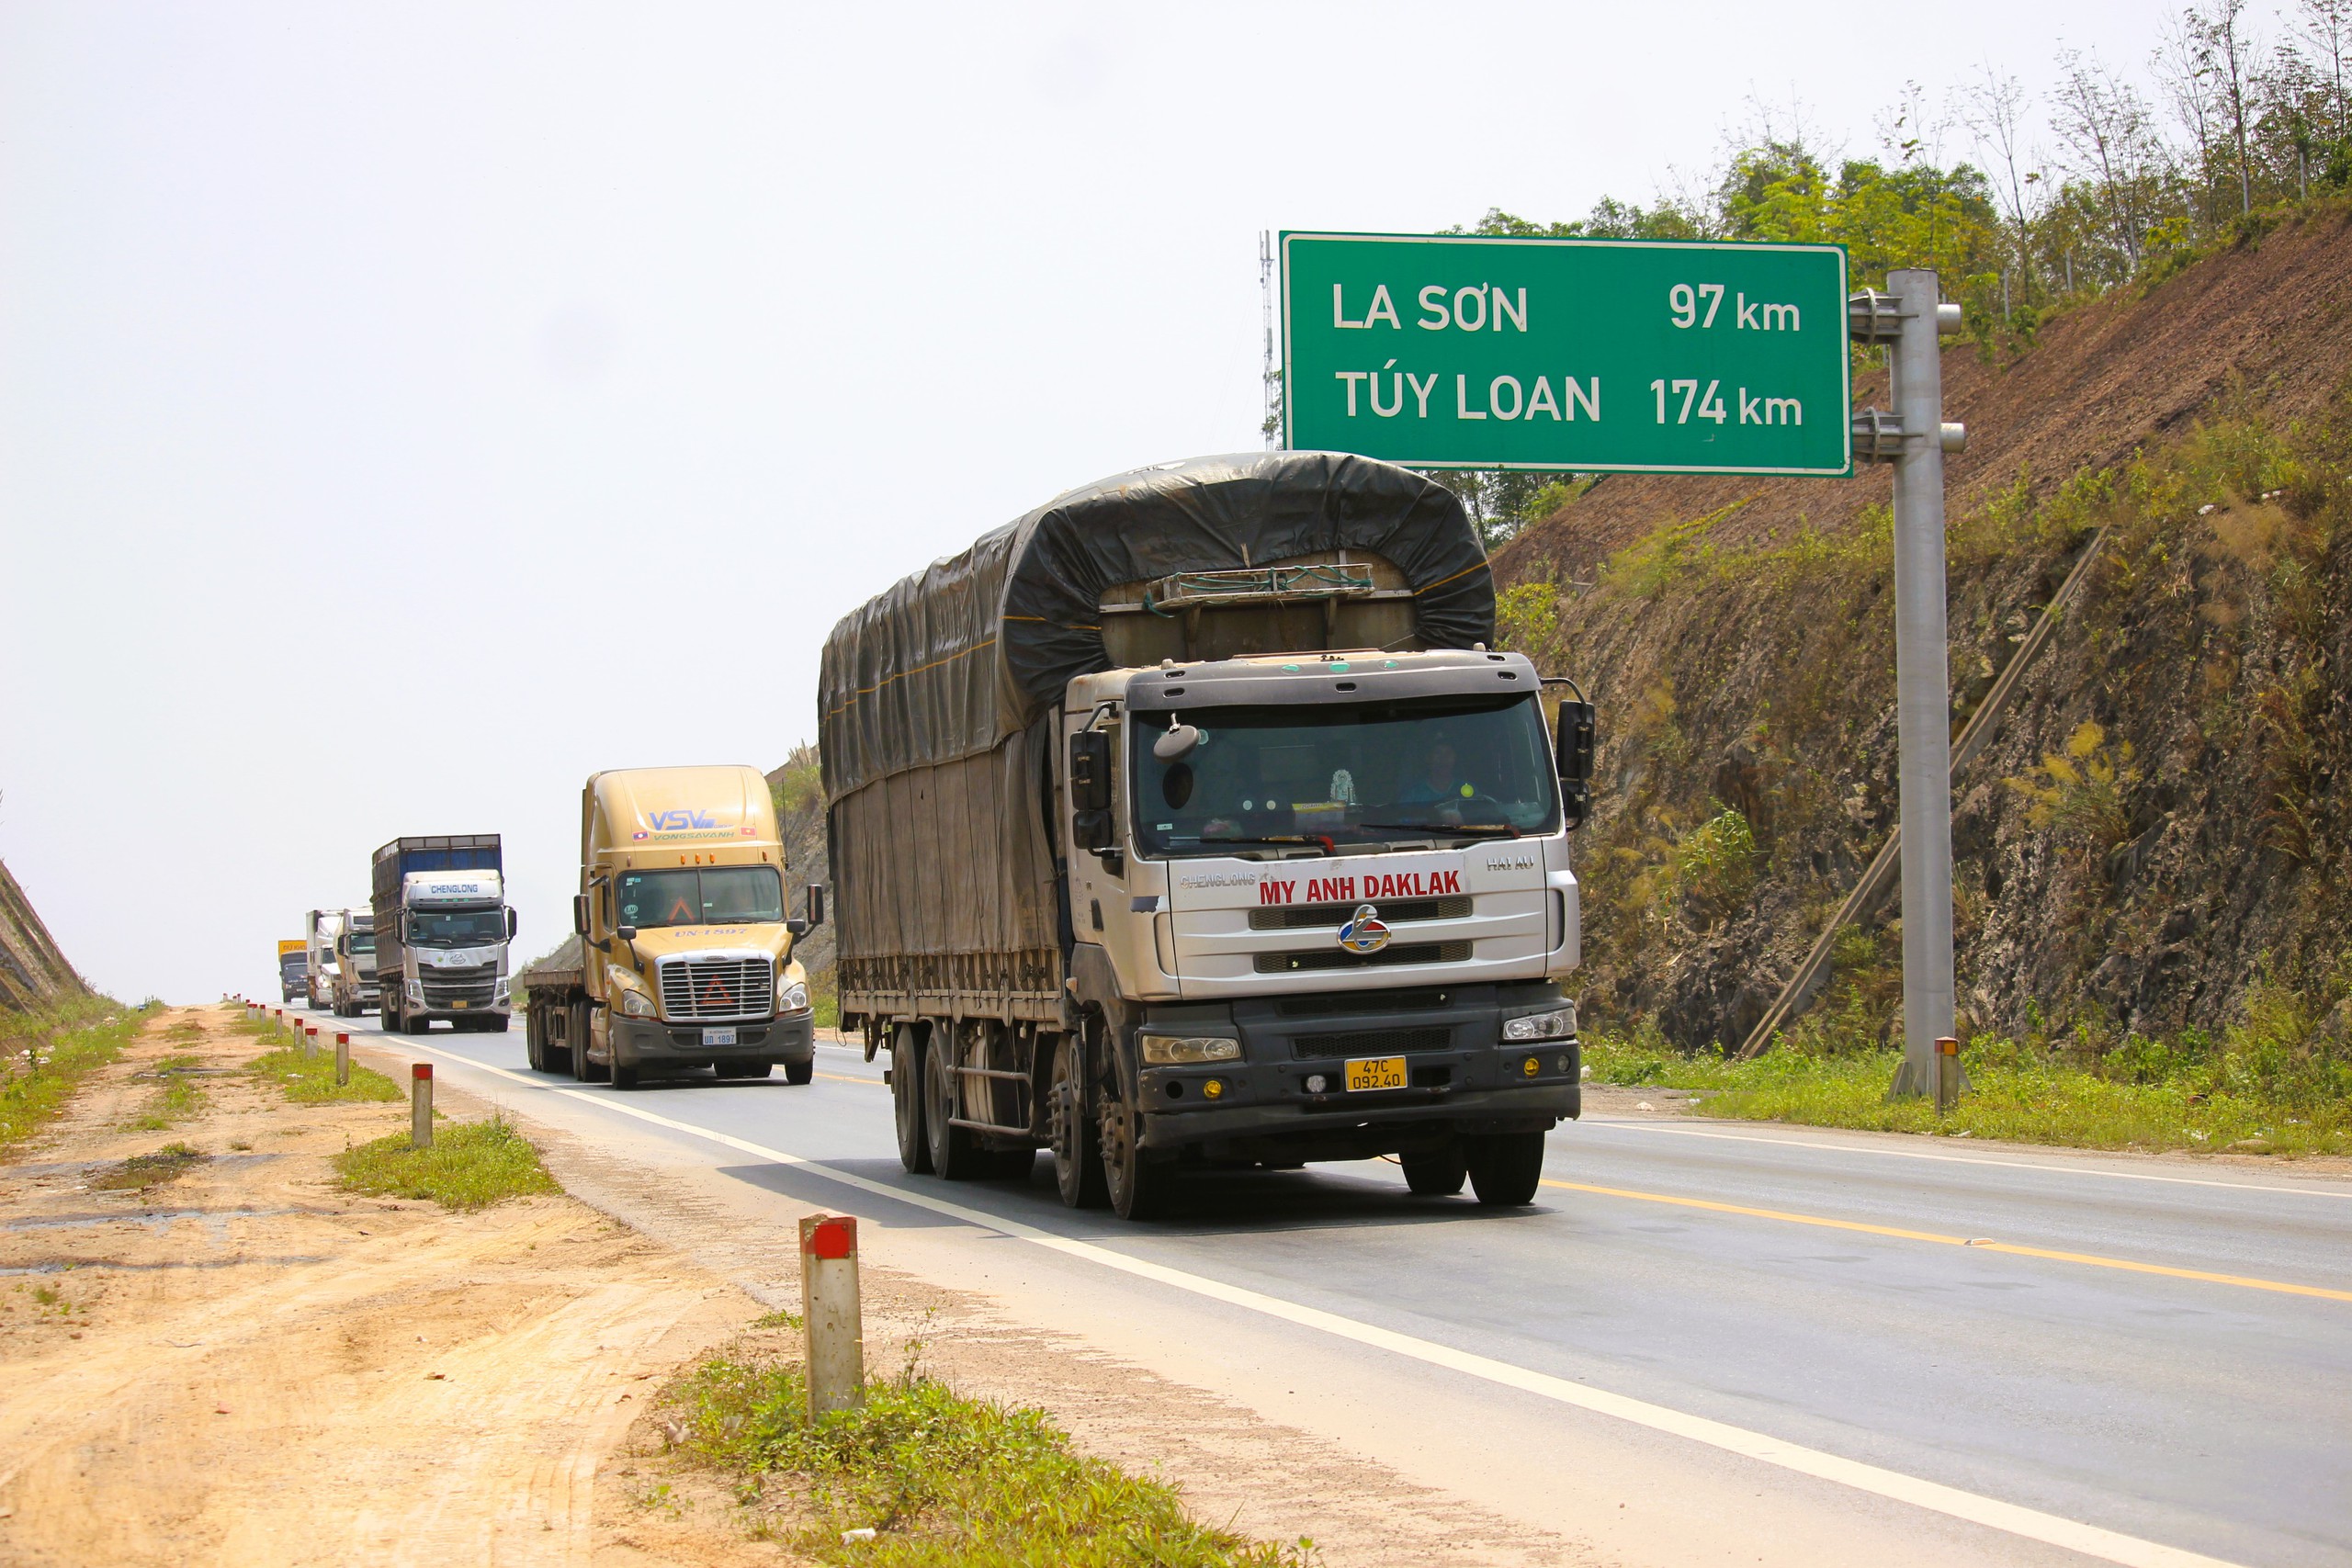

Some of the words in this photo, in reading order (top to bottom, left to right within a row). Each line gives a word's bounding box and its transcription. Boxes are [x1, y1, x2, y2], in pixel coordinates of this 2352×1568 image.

[1332, 283, 1402, 330] LA
[1417, 282, 1527, 333] SƠN
[1668, 283, 1724, 329] 97
[1736, 291, 1801, 332] km
[1335, 358, 1439, 418] TÚY
[1457, 373, 1600, 422] LOAN
[1650, 378, 1726, 424] 174
[1739, 387, 1803, 426] km
[649, 809, 707, 830] VSV
[654, 831, 735, 840] VONGSAVANH
[1487, 856, 1511, 871] HAI
[1515, 855, 1533, 870] AU
[1181, 872, 1255, 889] CHENGLONG
[1259, 881, 1297, 905] MY
[1306, 876, 1356, 903] ANH
[1363, 870, 1461, 898] DAKLAK
[431, 884, 478, 894] CHENGLONG
[718, 1034, 735, 1043] 1897
[1363, 1060, 1388, 1073] 47C
[1353, 1074, 1400, 1089] 092.40
